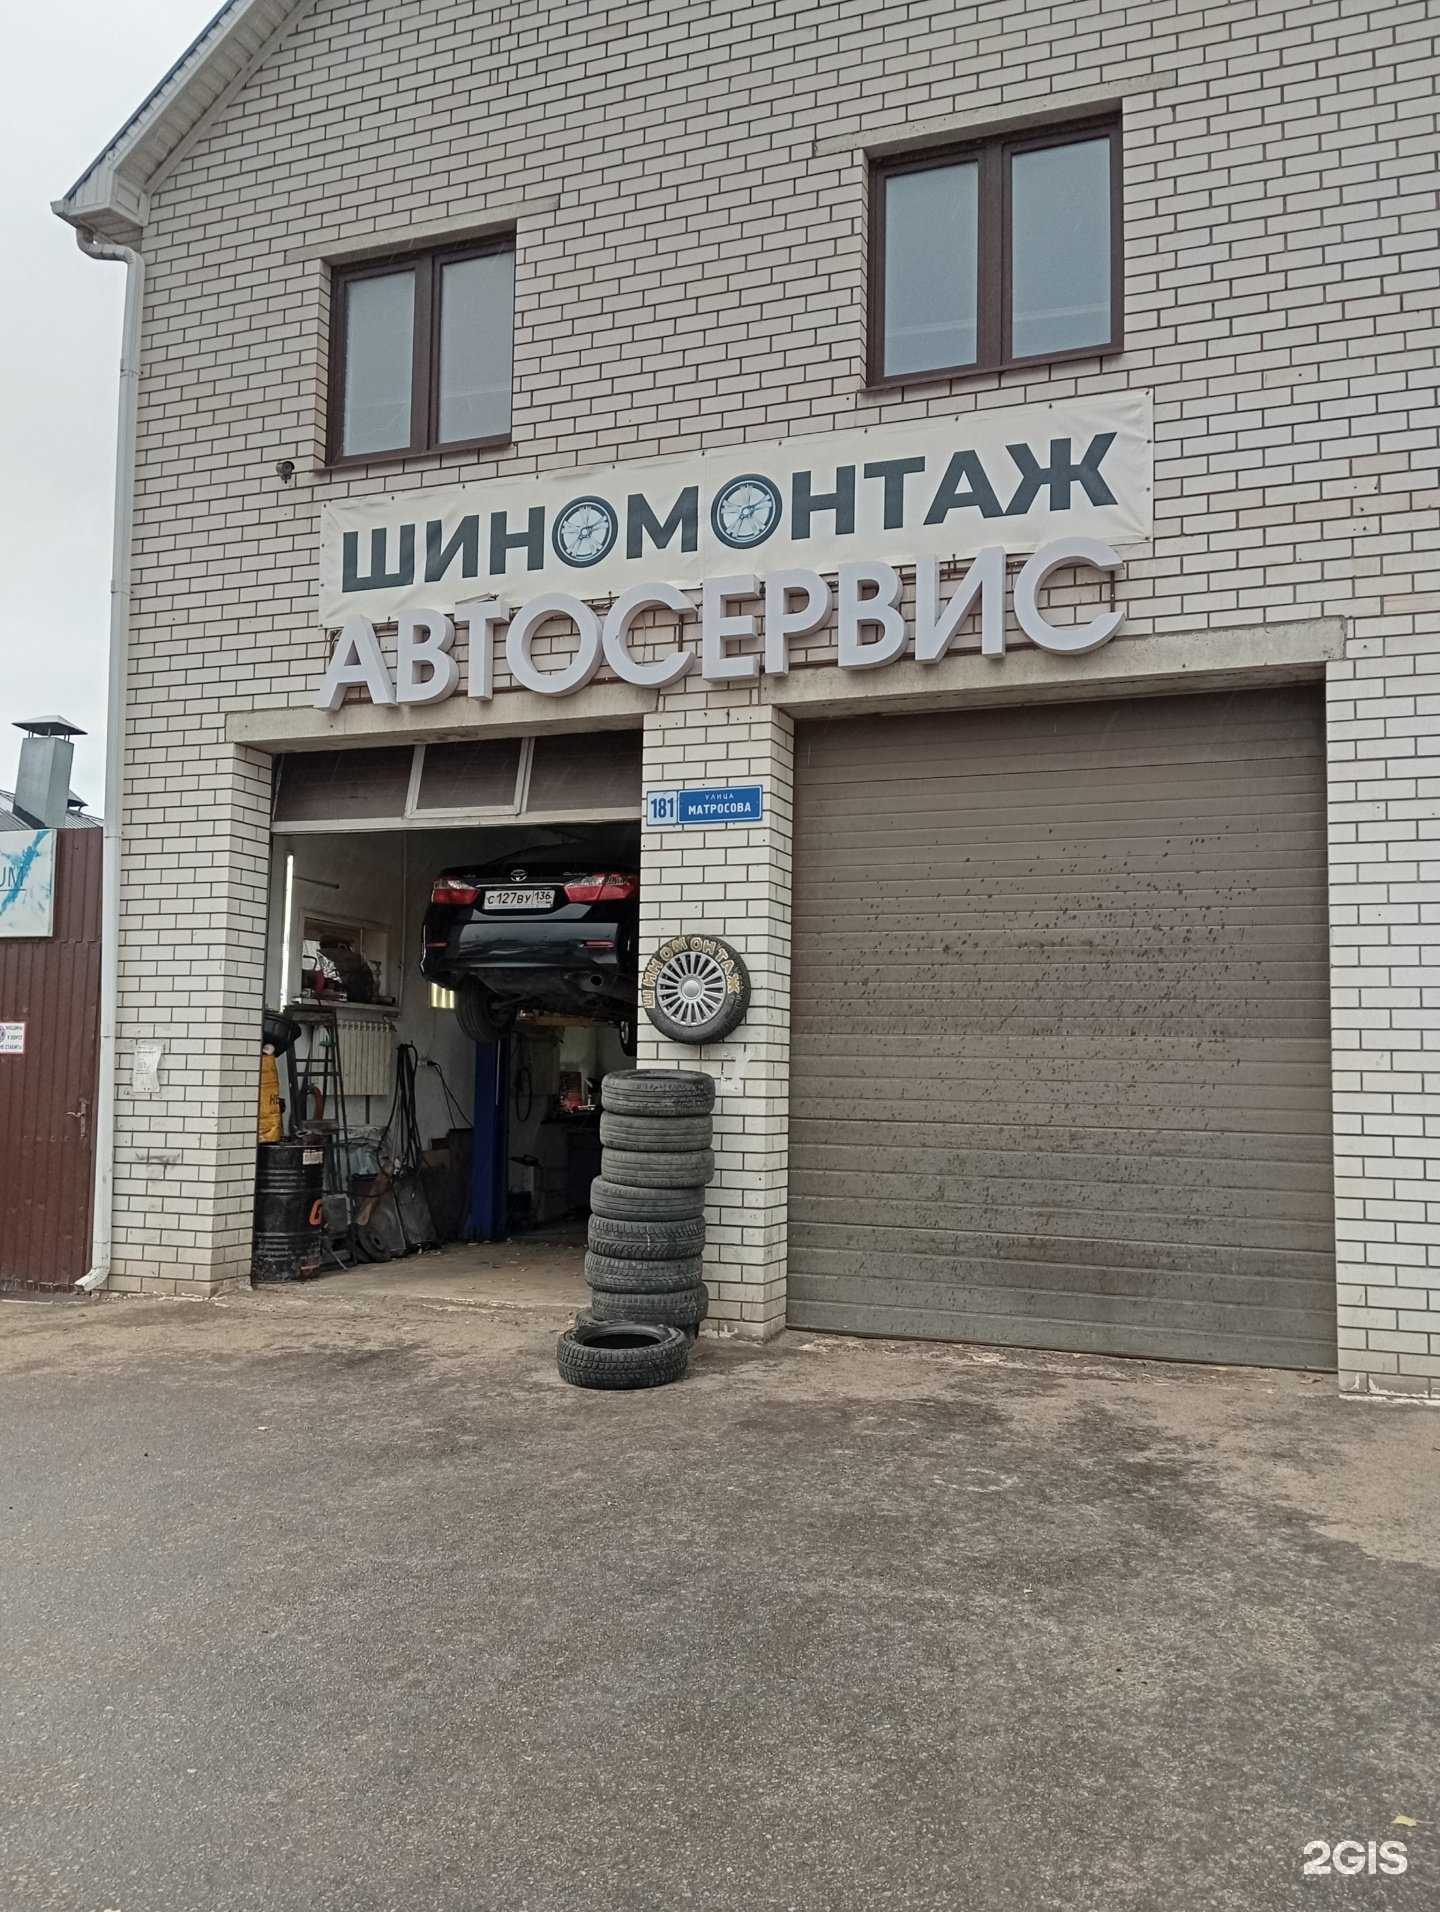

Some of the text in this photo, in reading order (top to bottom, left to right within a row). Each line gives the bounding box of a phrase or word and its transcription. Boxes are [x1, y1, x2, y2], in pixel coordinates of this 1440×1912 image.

[341, 432, 1119, 594] ШИНОМОНТАЖ
[313, 536, 1125, 713] АВТОСЕРВИС
[650, 797, 675, 818] 181
[704, 793, 735, 801] УЛИЦА
[688, 802, 752, 816] МАТРОСОВА
